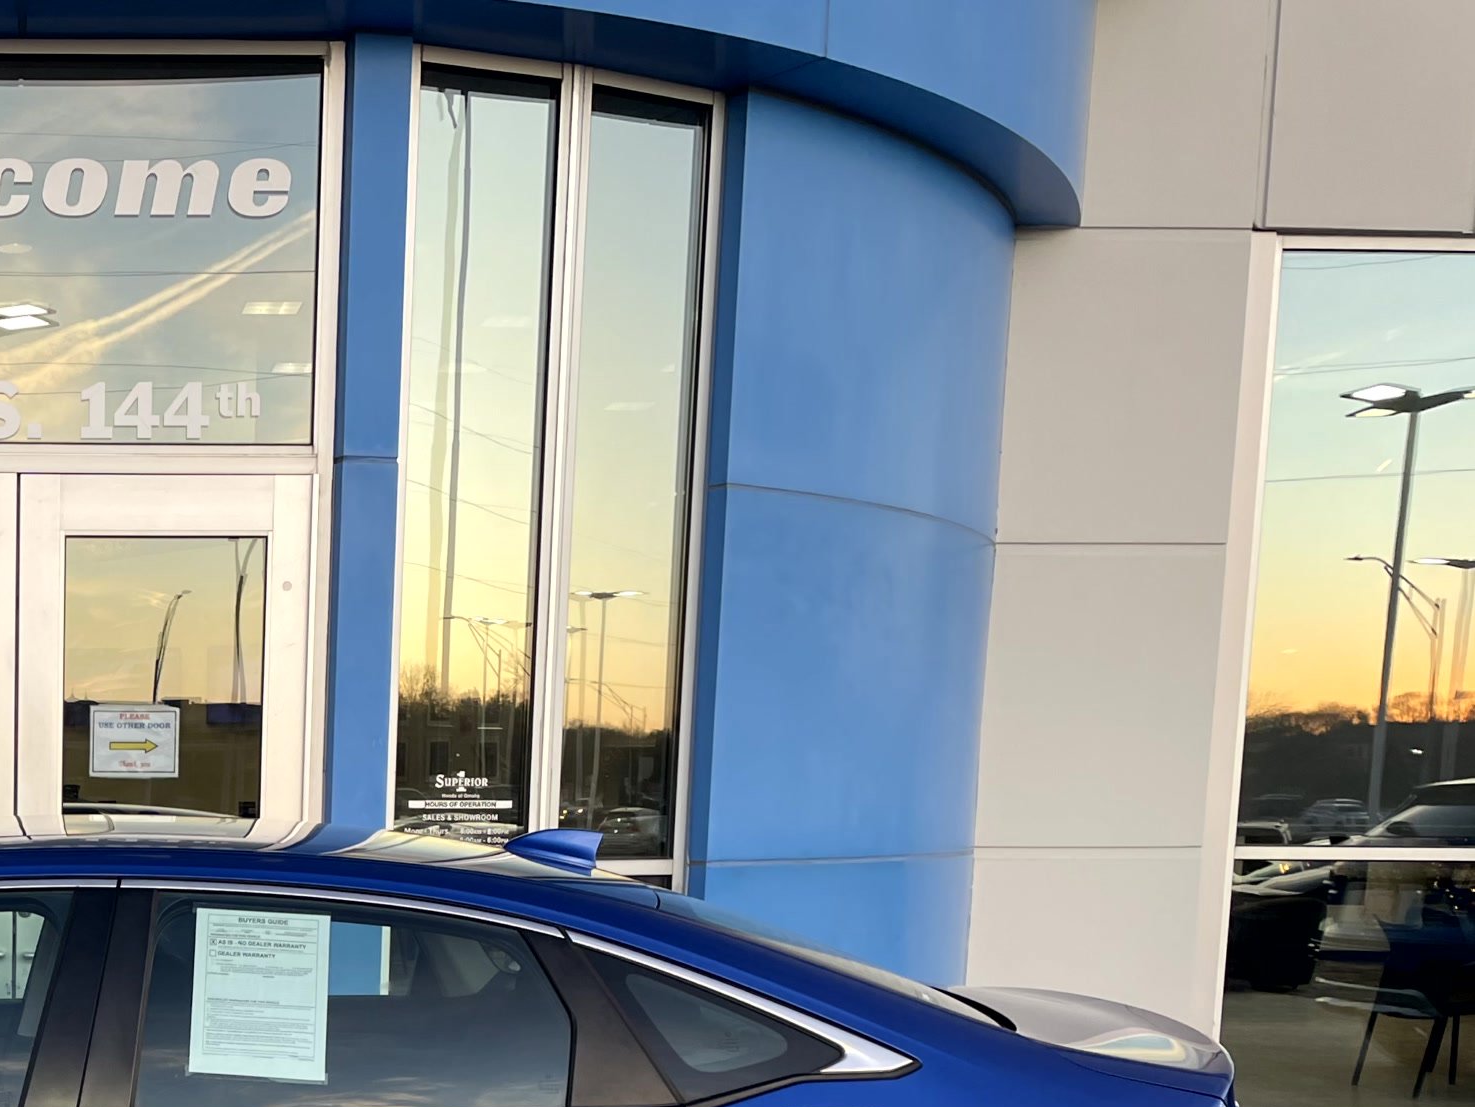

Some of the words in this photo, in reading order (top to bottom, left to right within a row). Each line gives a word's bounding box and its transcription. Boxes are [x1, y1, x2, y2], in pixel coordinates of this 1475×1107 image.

[422, 813, 445, 821] SALES
[453, 813, 499, 821] SHOWROOM
[238, 917, 267, 925] BUYERS
[267, 918, 289, 926] GUIDE
[273, 942, 306, 950] WARRANTY
[217, 950, 241, 958] DEALER
[243, 951, 275, 959] WARRANTY
